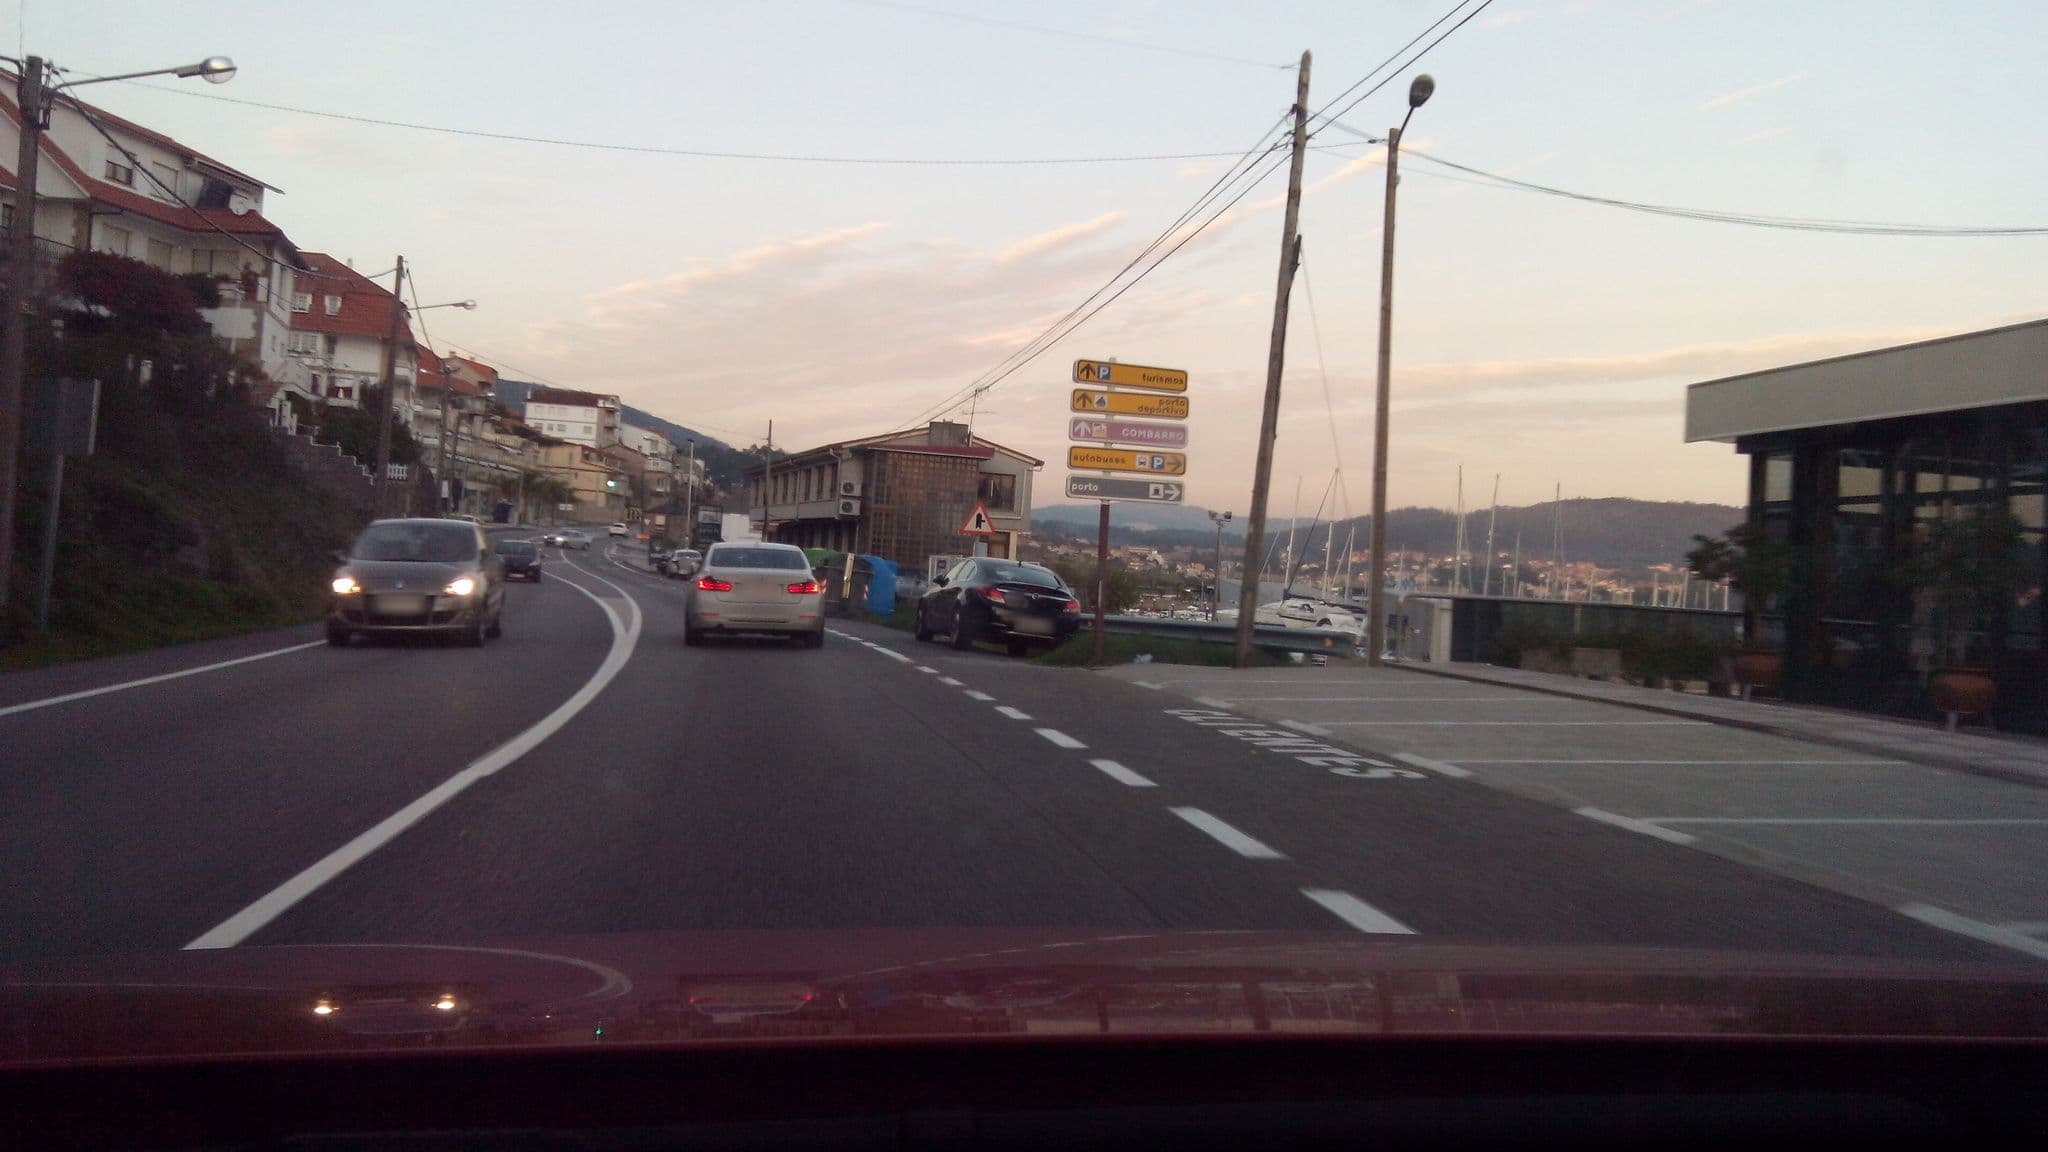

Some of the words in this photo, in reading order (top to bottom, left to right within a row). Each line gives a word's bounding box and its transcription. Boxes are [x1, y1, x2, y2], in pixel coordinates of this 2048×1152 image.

[1142, 373, 1184, 385] turismos
[1159, 398, 1186, 408] porto
[1137, 405, 1185, 416] deportivo
[1073, 454, 1126, 465] autobuses
[1071, 482, 1098, 492] porto
[1163, 708, 1428, 779] CLIENTES
